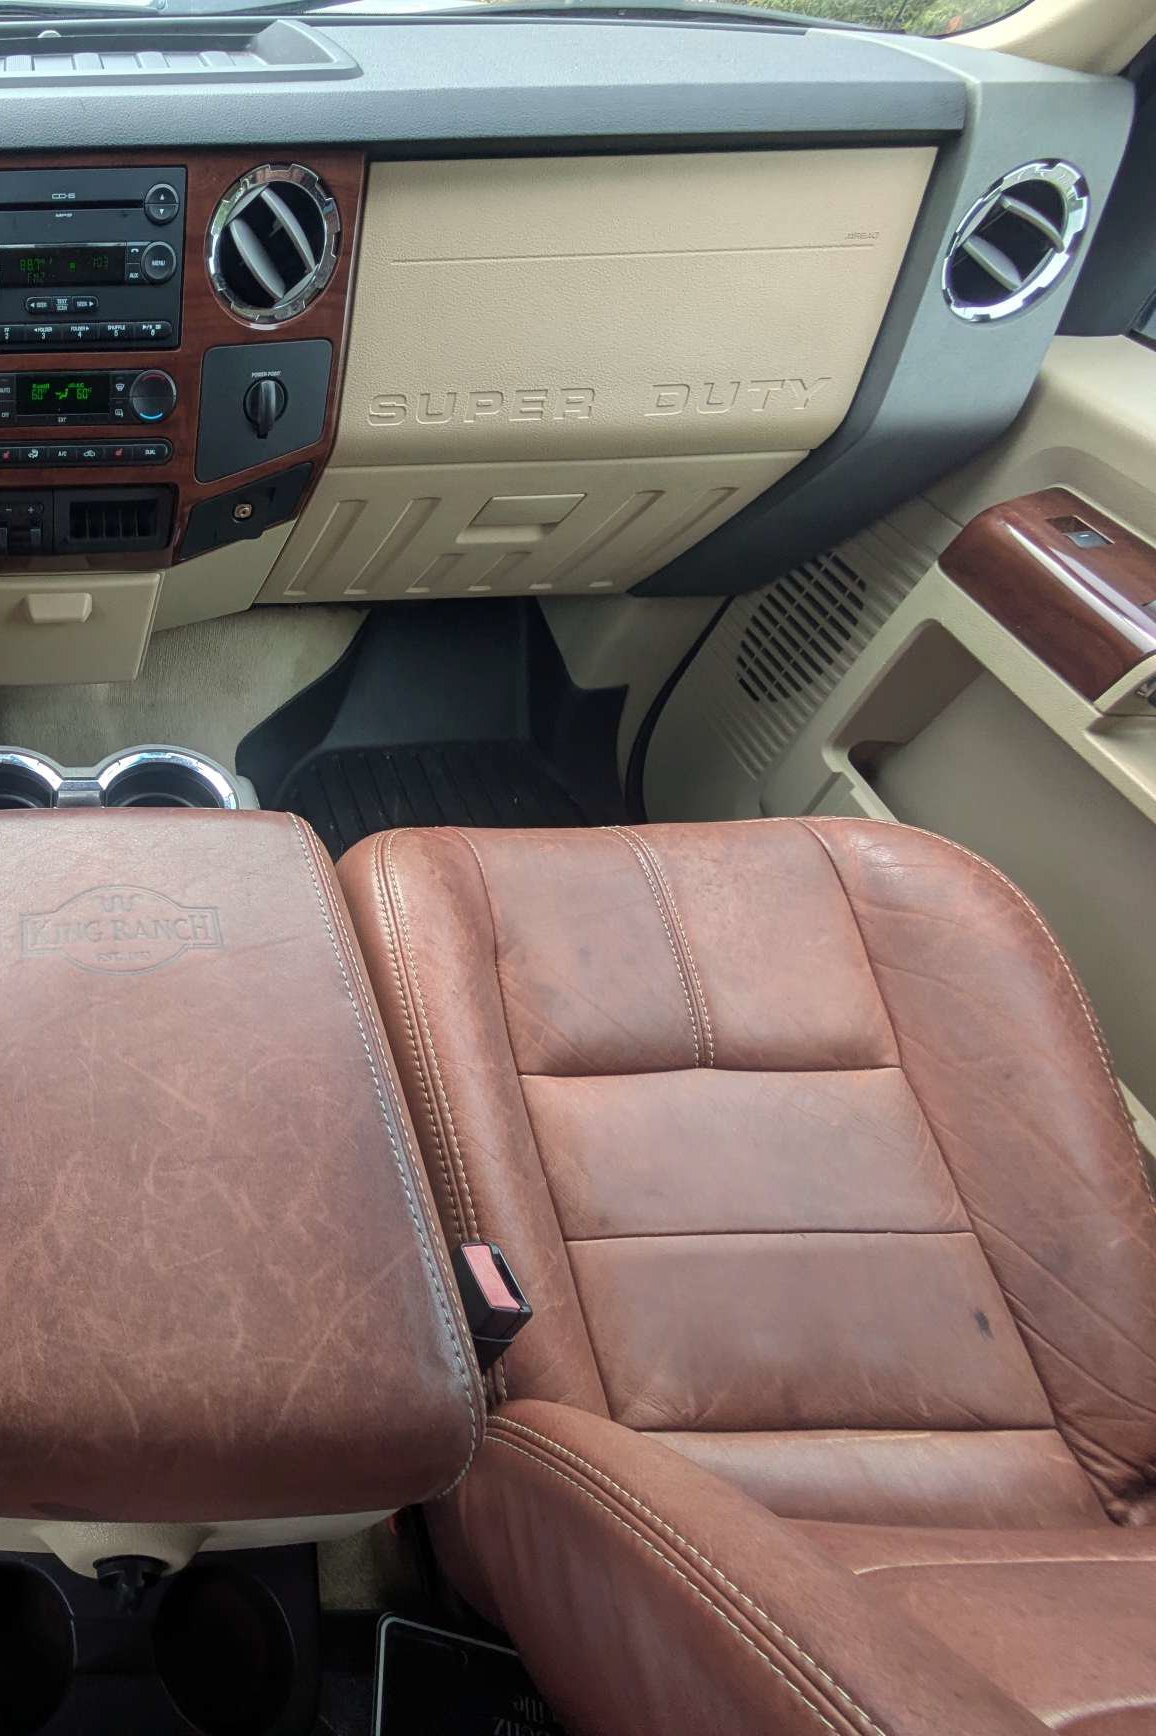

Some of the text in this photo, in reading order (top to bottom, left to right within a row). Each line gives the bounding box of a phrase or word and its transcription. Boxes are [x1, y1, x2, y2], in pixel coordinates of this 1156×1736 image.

[367, 376, 832, 427] SUPER DUTY
[28, 914, 215, 945] KING RANCH
